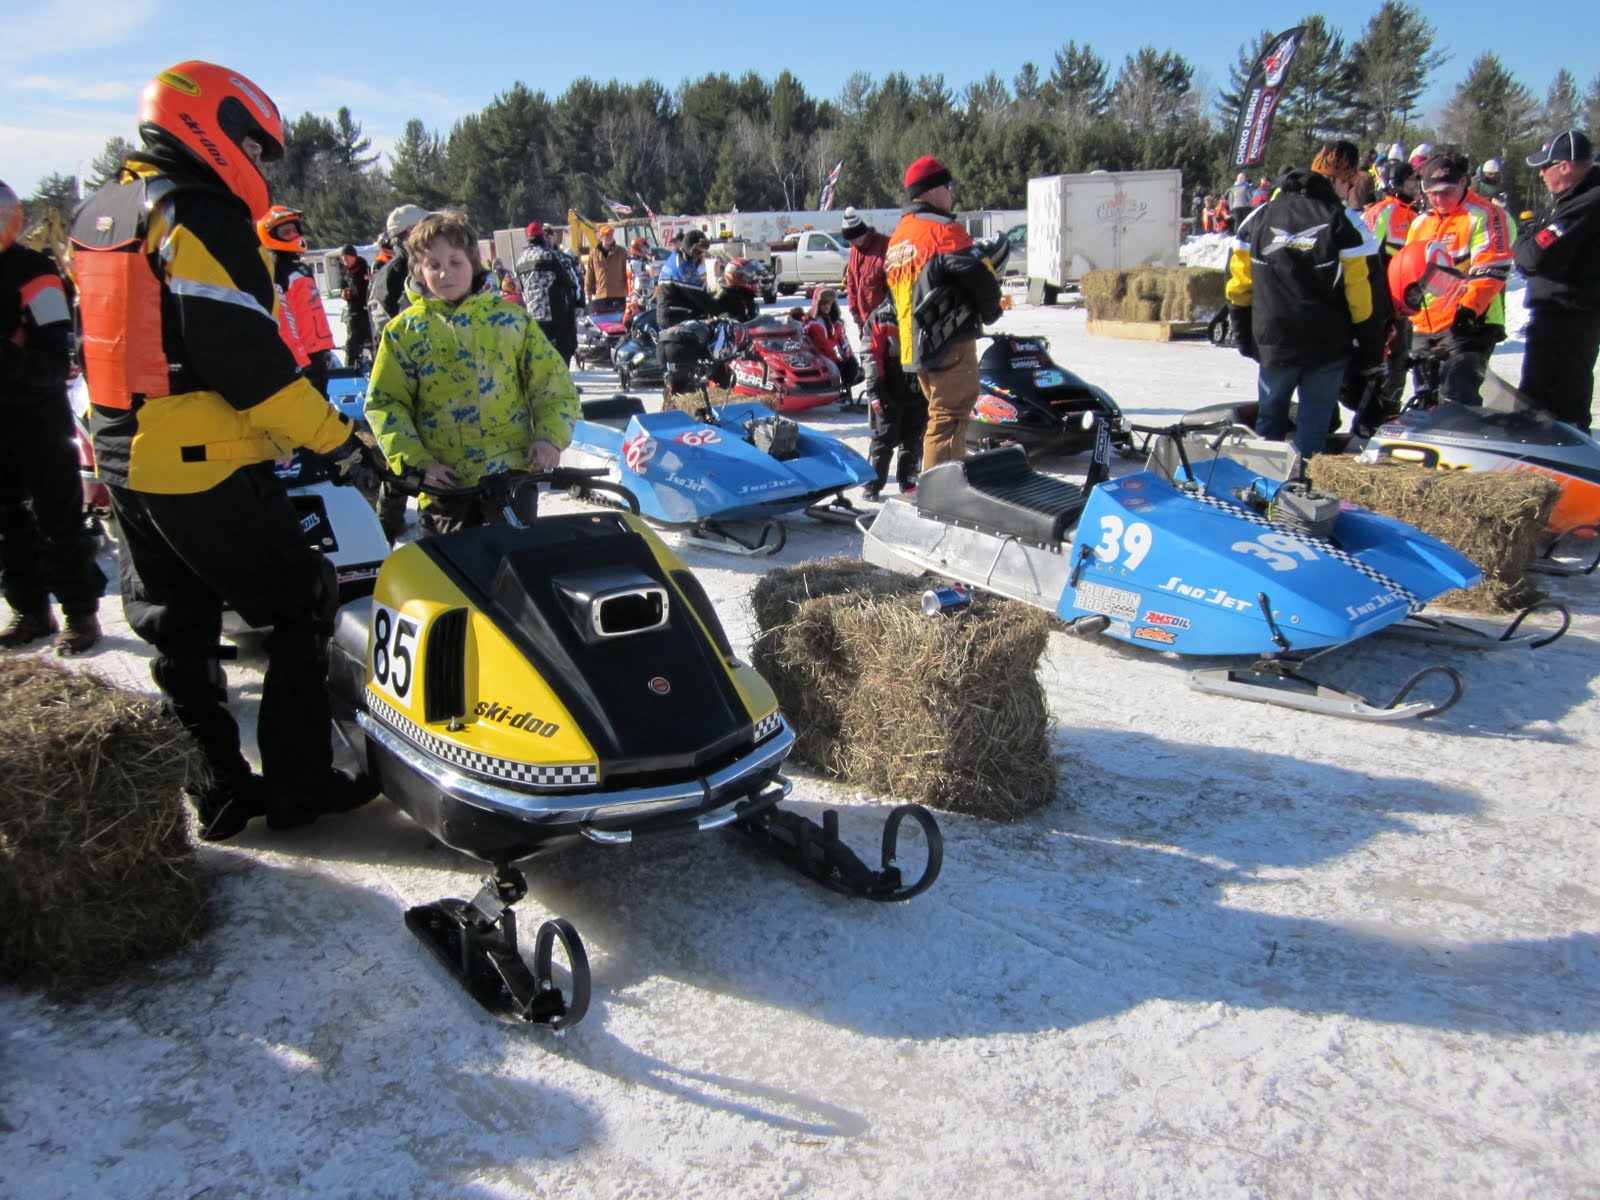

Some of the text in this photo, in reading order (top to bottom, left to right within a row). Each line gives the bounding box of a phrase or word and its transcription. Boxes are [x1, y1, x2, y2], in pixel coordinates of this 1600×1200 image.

[178, 112, 228, 166] ski-doo
[1236, 88, 1260, 164] CHOKO DESIGN
[1250, 96, 1271, 159] POWERSPORTS
[626, 437, 657, 475] 62
[682, 429, 722, 446] 62
[1096, 417, 1109, 462] SCOTT
[302, 513, 320, 530] OIL
[1095, 515, 1152, 571] 39
[1231, 533, 1321, 571] 39
[1076, 596, 1112, 616] BROS
[1077, 582, 1140, 608] COULSON
[1145, 612, 1189, 628] AMSOIL
[373, 607, 418, 698] 85
[474, 700, 560, 738] ski-doo
